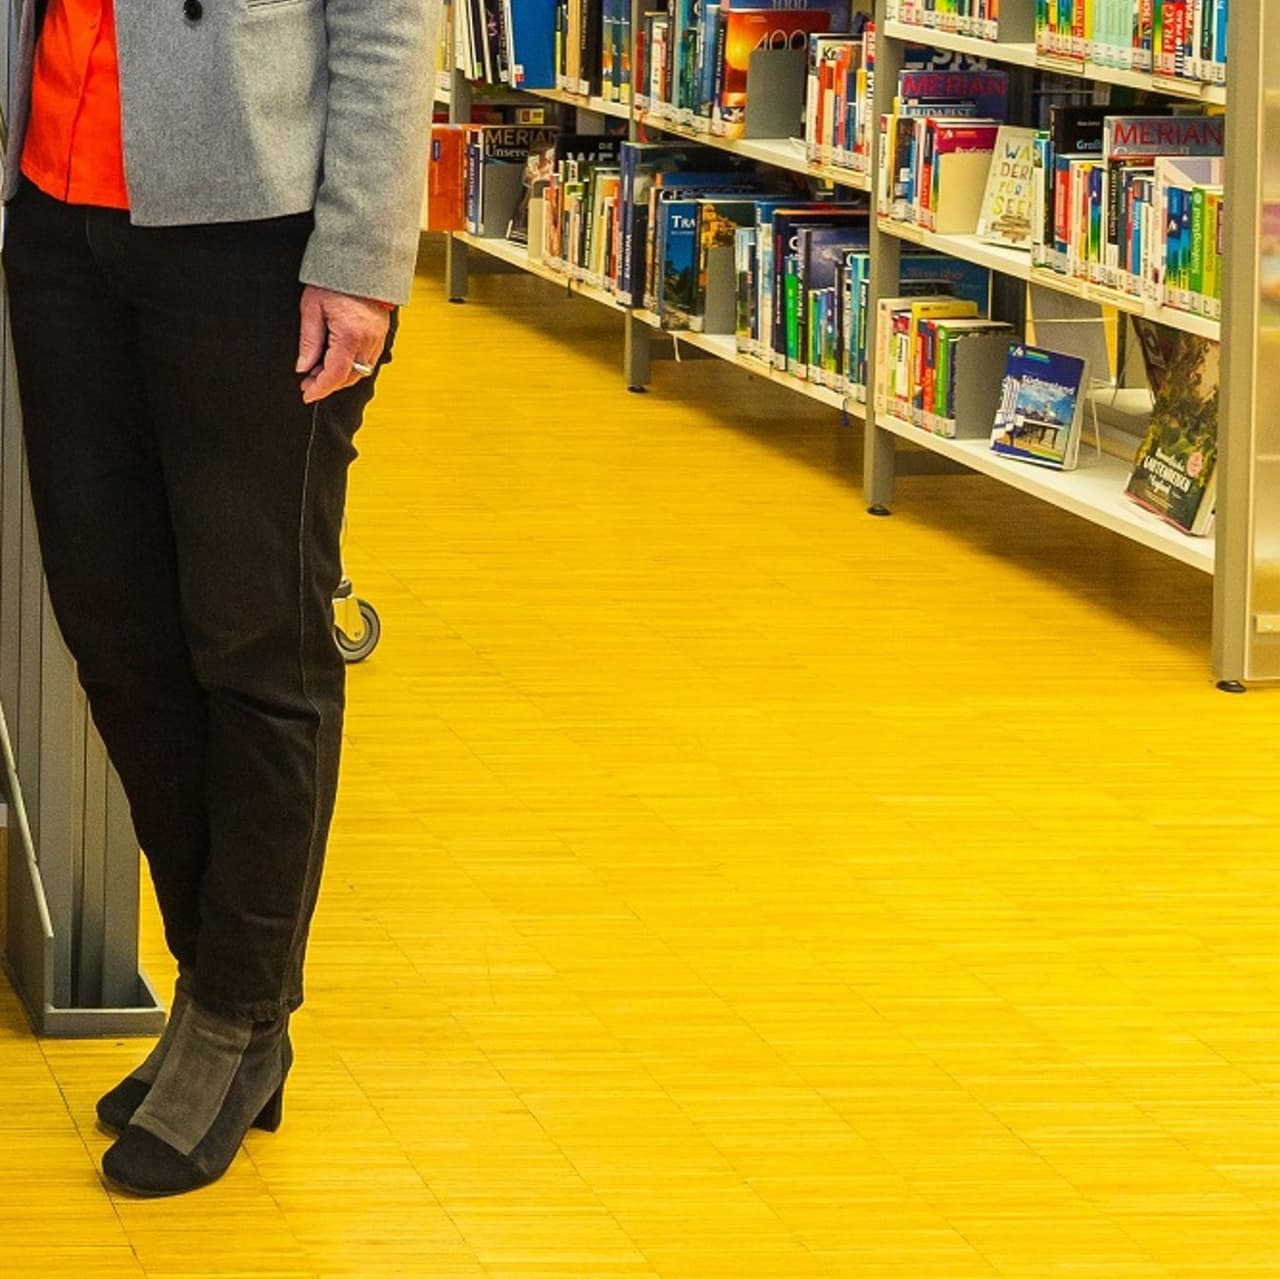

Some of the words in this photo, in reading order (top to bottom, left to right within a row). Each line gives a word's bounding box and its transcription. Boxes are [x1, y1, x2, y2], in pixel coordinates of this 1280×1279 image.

[1164, 4, 1175, 51] PRAG
[902, 73, 1008, 97] MERIAN
[1113, 120, 1224, 146] MERIAN
